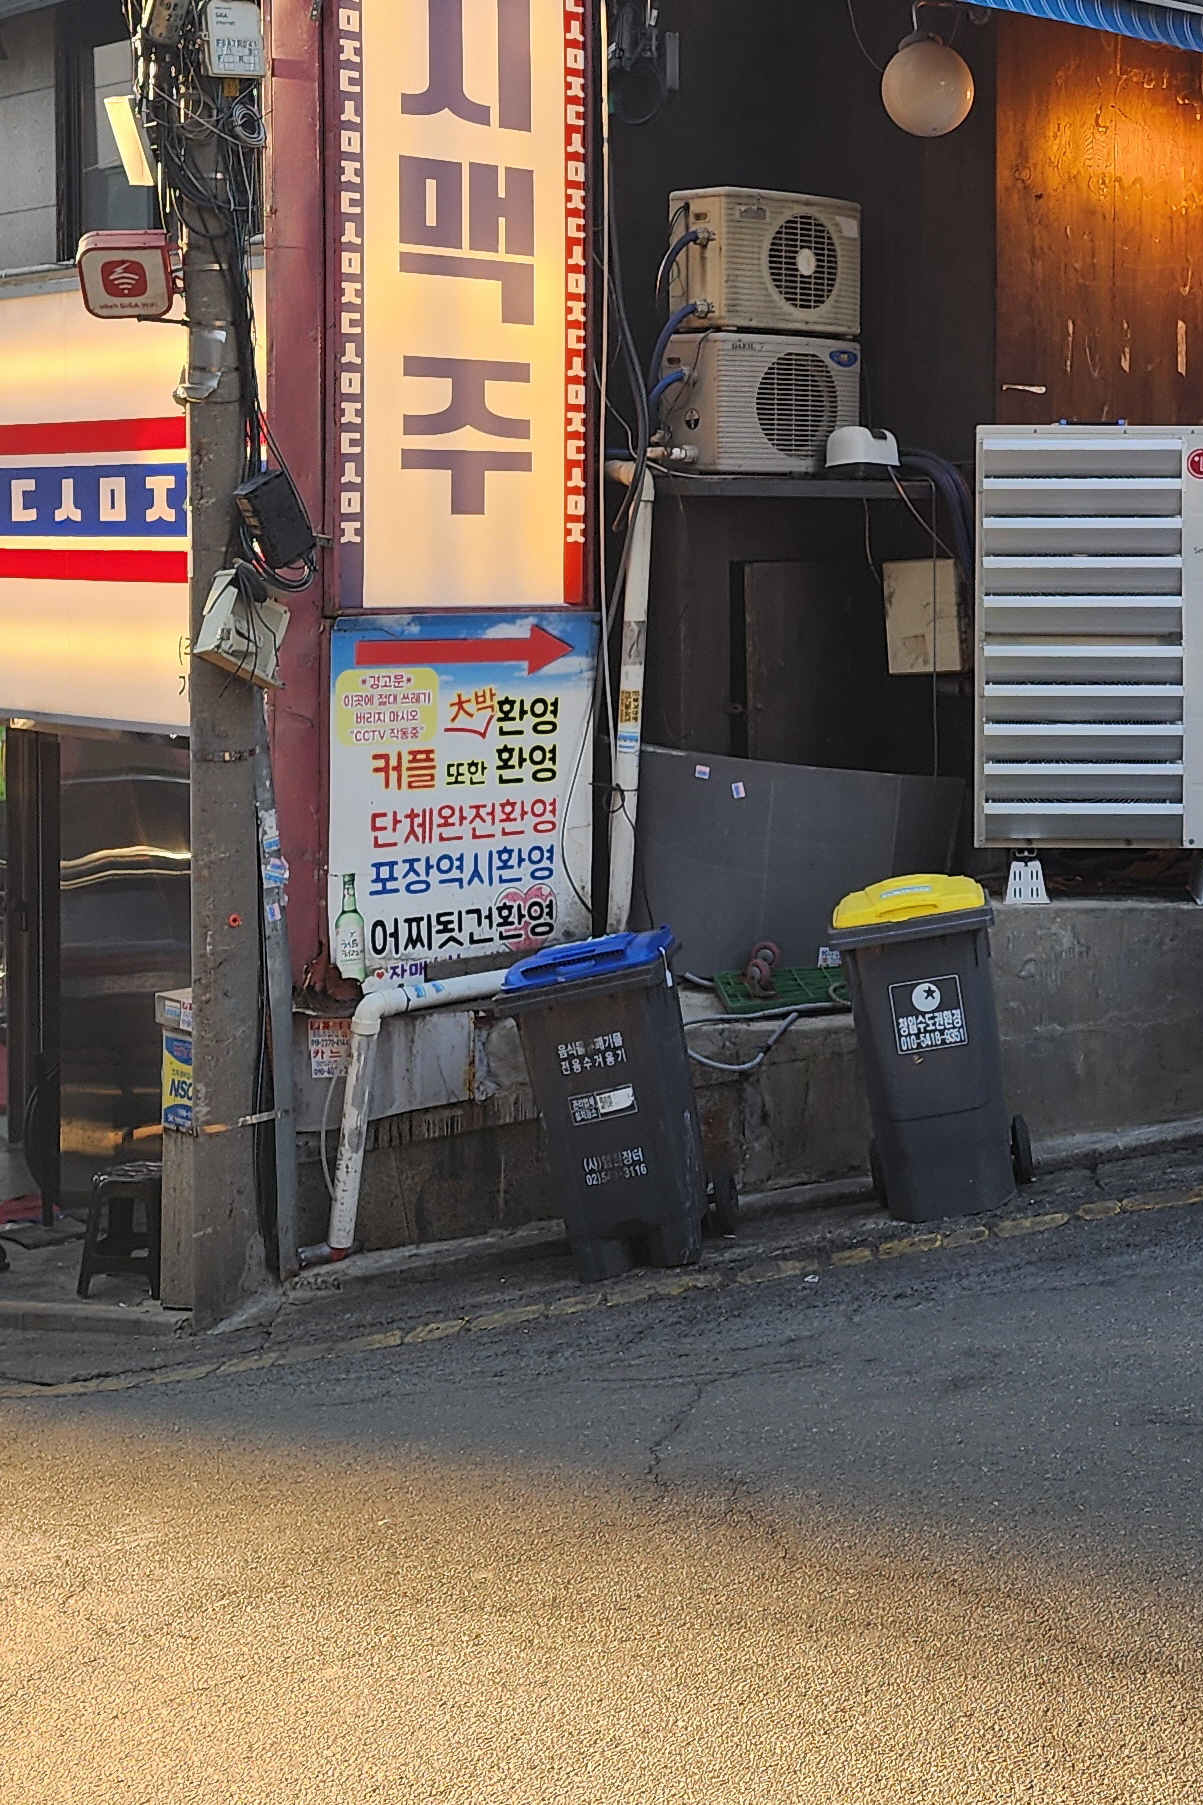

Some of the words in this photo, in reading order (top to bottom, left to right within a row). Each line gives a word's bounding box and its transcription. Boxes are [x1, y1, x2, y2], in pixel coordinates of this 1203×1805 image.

[343, 693, 375, 708] 이곳에
[377, 692, 398, 706] 절대
[400, 691, 432, 705] 쓰레기
[355, 710, 386, 724] 버리지
[388, 709, 419, 723] 마시오
[496, 696, 560, 737] 환영
[371, 748, 437, 791] 커플
[445, 759, 488, 786] 또한
[495, 743, 558, 785] 환영
[370, 797, 558, 849] 단체완전환영
[368, 843, 555, 897] 포장역시환영
[560, 1049, 627, 1075] 전용수거용기
